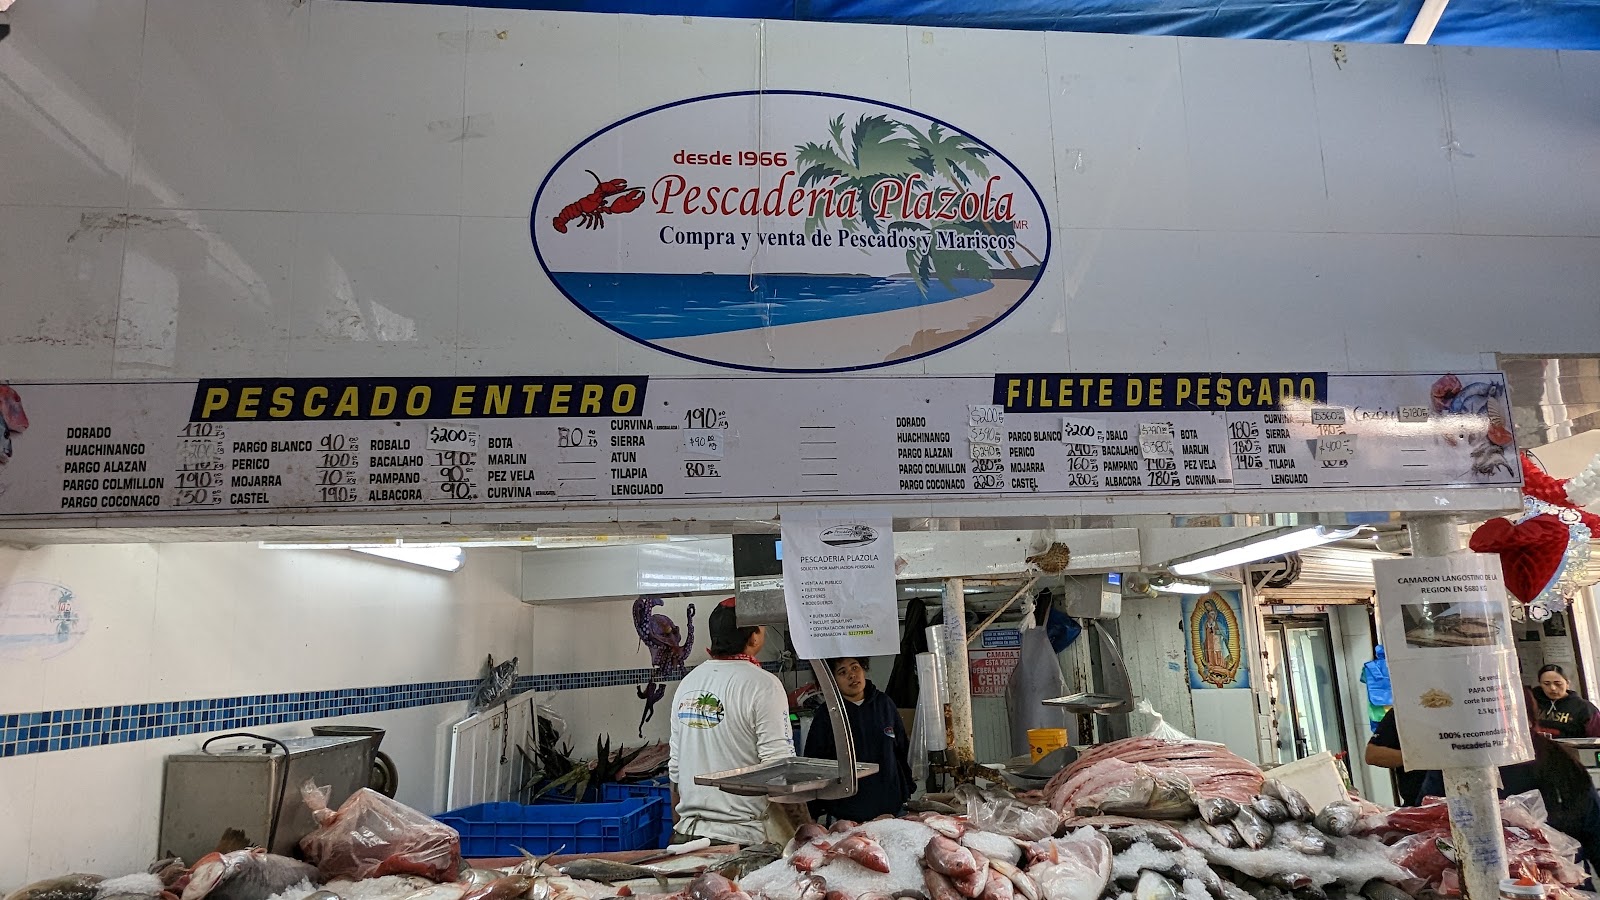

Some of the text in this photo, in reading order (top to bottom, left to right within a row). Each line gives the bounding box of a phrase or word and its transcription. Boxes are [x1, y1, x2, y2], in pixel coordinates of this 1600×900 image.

[673, 150, 787, 166] desde 1966
[651, 169, 1015, 222] Pescadería Plazola
[1013, 220, 1028, 230] MR
[660, 225, 1015, 253] Compra y venta de Pescados y Mariscos
[1007, 378, 1316, 407] FILETE DE PESCADO
[201, 384, 637, 418] PESCADO ENTERO
[684, 408, 717, 429] 190
[971, 407, 998, 424] $200
[610, 419, 653, 430] CURVINA
[896, 417, 926, 427] DORADO
[67, 427, 111, 438] DORADO
[182, 423, 213, 436] 110
[1065, 422, 1094, 436] $200
[1180, 429, 1198, 439] BOTA
[1229, 421, 1250, 438] 180
[1266, 428, 1290, 439] SIERRA
[431, 427, 467, 443] $200
[897, 432, 950, 443] HUACHINANGO
[1008, 430, 1062, 442] PARGO BLANCO
[233, 440, 312, 452] PARGO BLANCO
[321, 434, 344, 450] 90
[370, 440, 410, 450] ROBALO
[488, 437, 513, 448] BOTA
[610, 436, 645, 446] SIERRA
[66, 444, 145, 456] HUACHINANGO
[898, 447, 952, 458] PARGO ALAZAN
[1010, 446, 1035, 457] PERICO
[1102, 445, 1138, 456] BACALAHO
[1182, 444, 1209, 455] MARLIN
[1268, 443, 1285, 454] ATUN
[322, 453, 350, 467] 100
[370, 456, 424, 467] BACALAHO
[436, 451, 470, 465] 190
[488, 453, 527, 464] MARLIN
[611, 451, 636, 463] ATUN
[1235, 455, 1254, 469] 140
[64, 461, 147, 473] PARGO ALAZAN
[232, 459, 269, 469] PERICO
[685, 462, 705, 477] 80
[899, 463, 966, 474] PARGO COLMILLON
[1011, 462, 1045, 473] MOJARRA
[1067, 457, 1089, 471] 160
[1104, 461, 1138, 471] PAMPANO
[1184, 459, 1216, 470] PEZ VELA
[1269, 459, 1295, 469] TILAPIA
[370, 472, 420, 483] PAMPANO
[440, 465, 464, 482] 90
[488, 471, 535, 482] PEZ VELA
[611, 468, 648, 479] TILAPIA
[1148, 471, 1170, 486] 180
[1271, 474, 1308, 484] LENGUADO
[63, 477, 164, 490] PARGO COLMILLON
[177, 472, 211, 488] 190
[231, 475, 282, 487] MOJARRA
[899, 479, 966, 489] PARGO COCONACO
[972, 475, 995, 489] 220
[1012, 478, 1038, 489] CASTEL
[1068, 473, 1091, 487] 280
[1105, 476, 1142, 486] ALBACORA
[1186, 475, 1216, 485] CURVINA
[318, 487, 347, 502] 190
[369, 489, 422, 500] ALBACORA
[441, 483, 470, 499] 90
[488, 487, 531, 498] CURVINA
[611, 484, 664, 495] LENGUADO
[62, 495, 160, 508] PARGO COCONACO
[230, 492, 269, 504] CASTEL
[1397, 576, 1440, 584] CAMARON
[1442, 575, 1484, 583] LANGOSTINO
[979, 675, 1009, 686] CERR
[1464, 697, 1480, 705] corte
